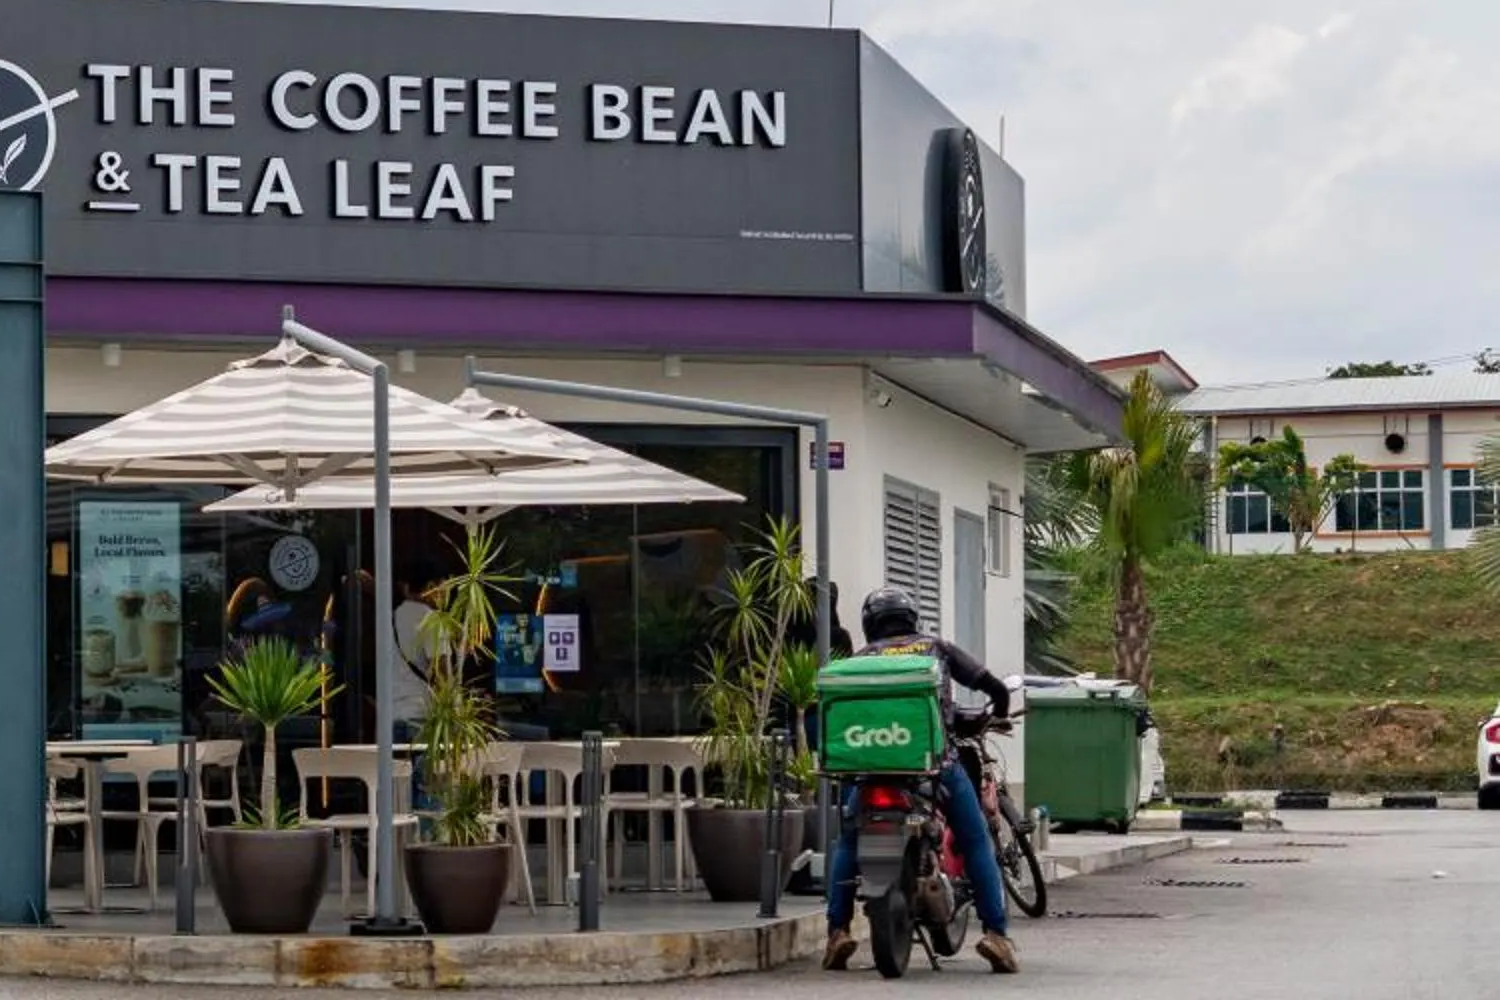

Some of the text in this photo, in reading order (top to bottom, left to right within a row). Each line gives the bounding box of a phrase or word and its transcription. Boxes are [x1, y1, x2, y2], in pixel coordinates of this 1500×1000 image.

[87, 64, 786, 147] THE COFFEE BEAN
[96, 151, 515, 222] & TEA LEAF
[844, 721, 912, 748] Grab
